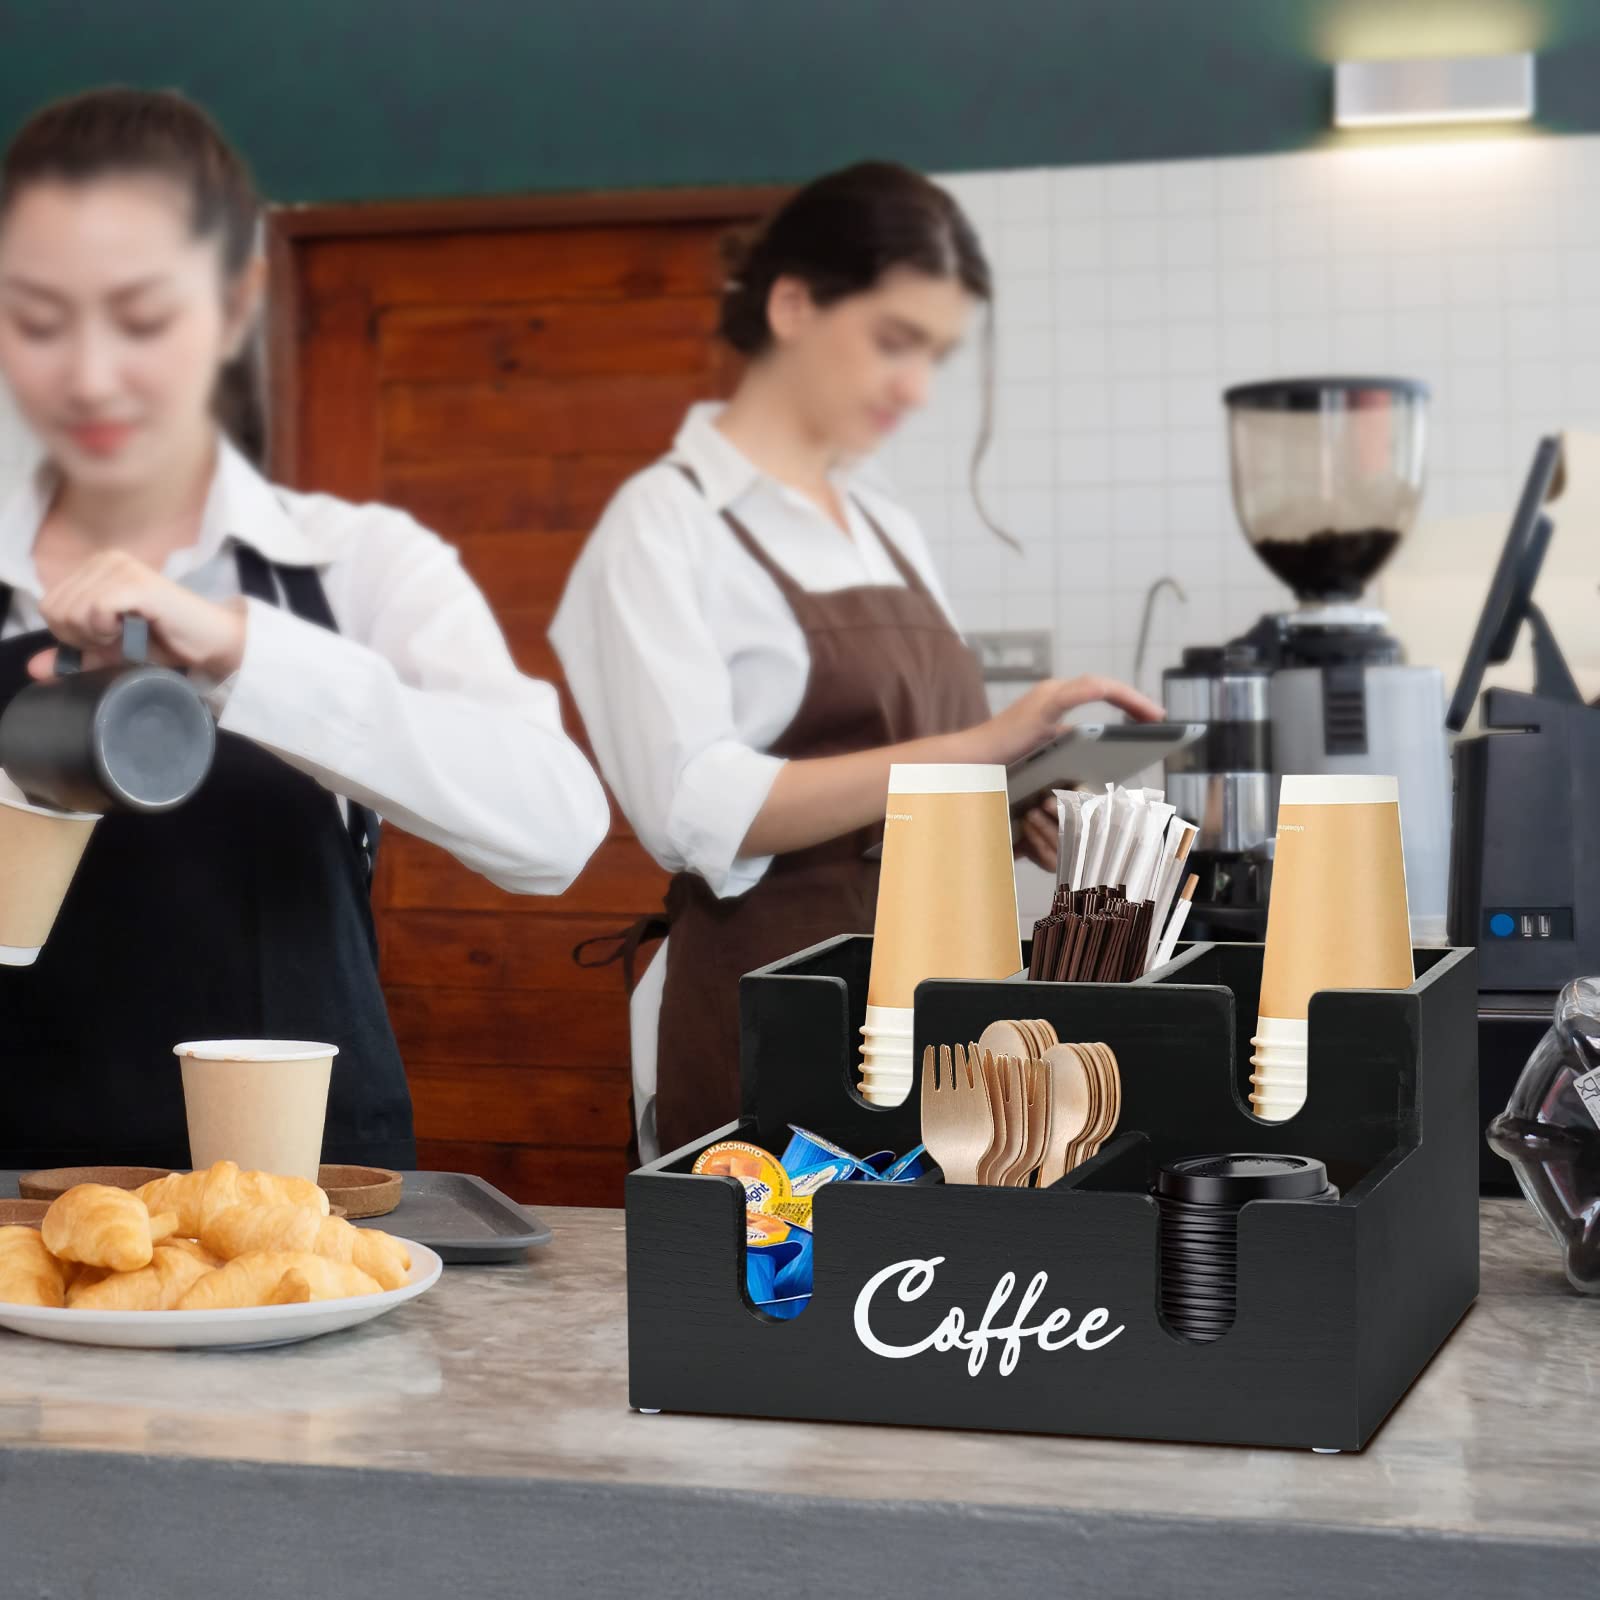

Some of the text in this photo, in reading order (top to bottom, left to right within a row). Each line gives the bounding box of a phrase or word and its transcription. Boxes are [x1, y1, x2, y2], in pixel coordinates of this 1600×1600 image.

[694, 1142, 762, 1174] AMEL MACCHIATO
[745, 1182, 770, 1203] light
[854, 1256, 1125, 1377] Coffee
